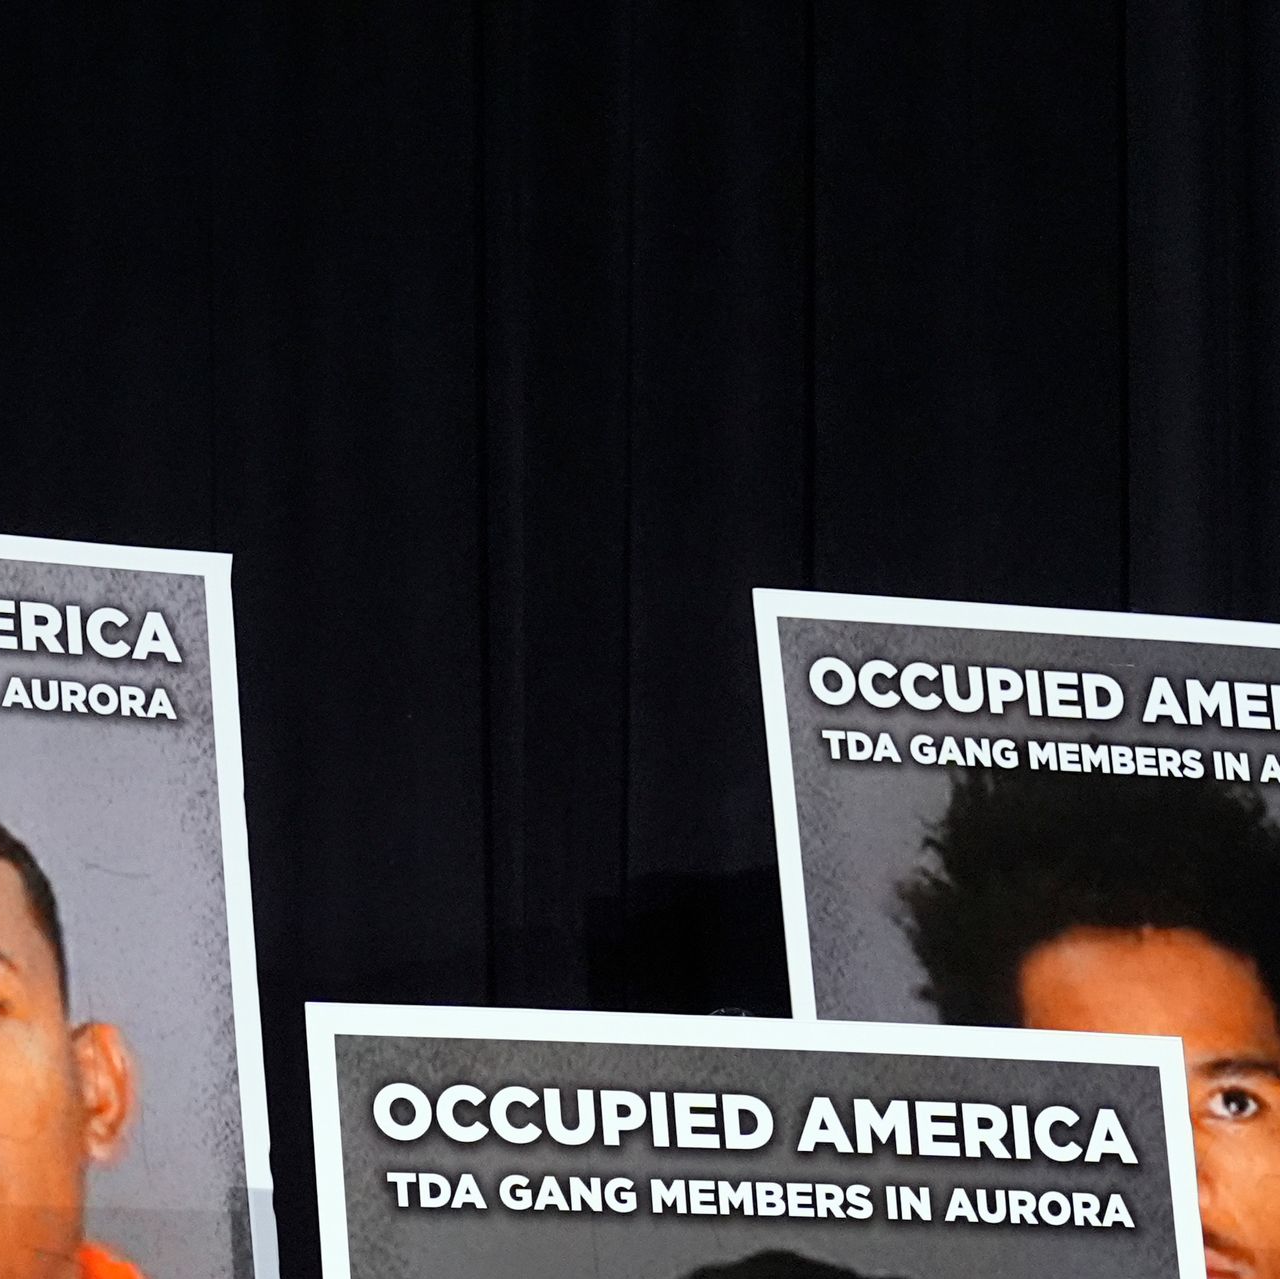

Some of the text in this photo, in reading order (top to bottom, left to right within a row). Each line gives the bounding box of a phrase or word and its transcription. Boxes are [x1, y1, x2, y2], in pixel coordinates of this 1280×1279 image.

[1, 676, 177, 720] AURORA
[809, 657, 1124, 720] OCCUPIED
[821, 729, 902, 763] TDA
[910, 734, 1019, 769] GANG
[1027, 741, 1205, 779] MEMBERS
[1213, 751, 1251, 781] IN
[373, 1082, 1139, 1164] OCCUPIED AMERICA
[386, 1172, 1135, 1228] TDA GANG MEMBERS IN AURORA
